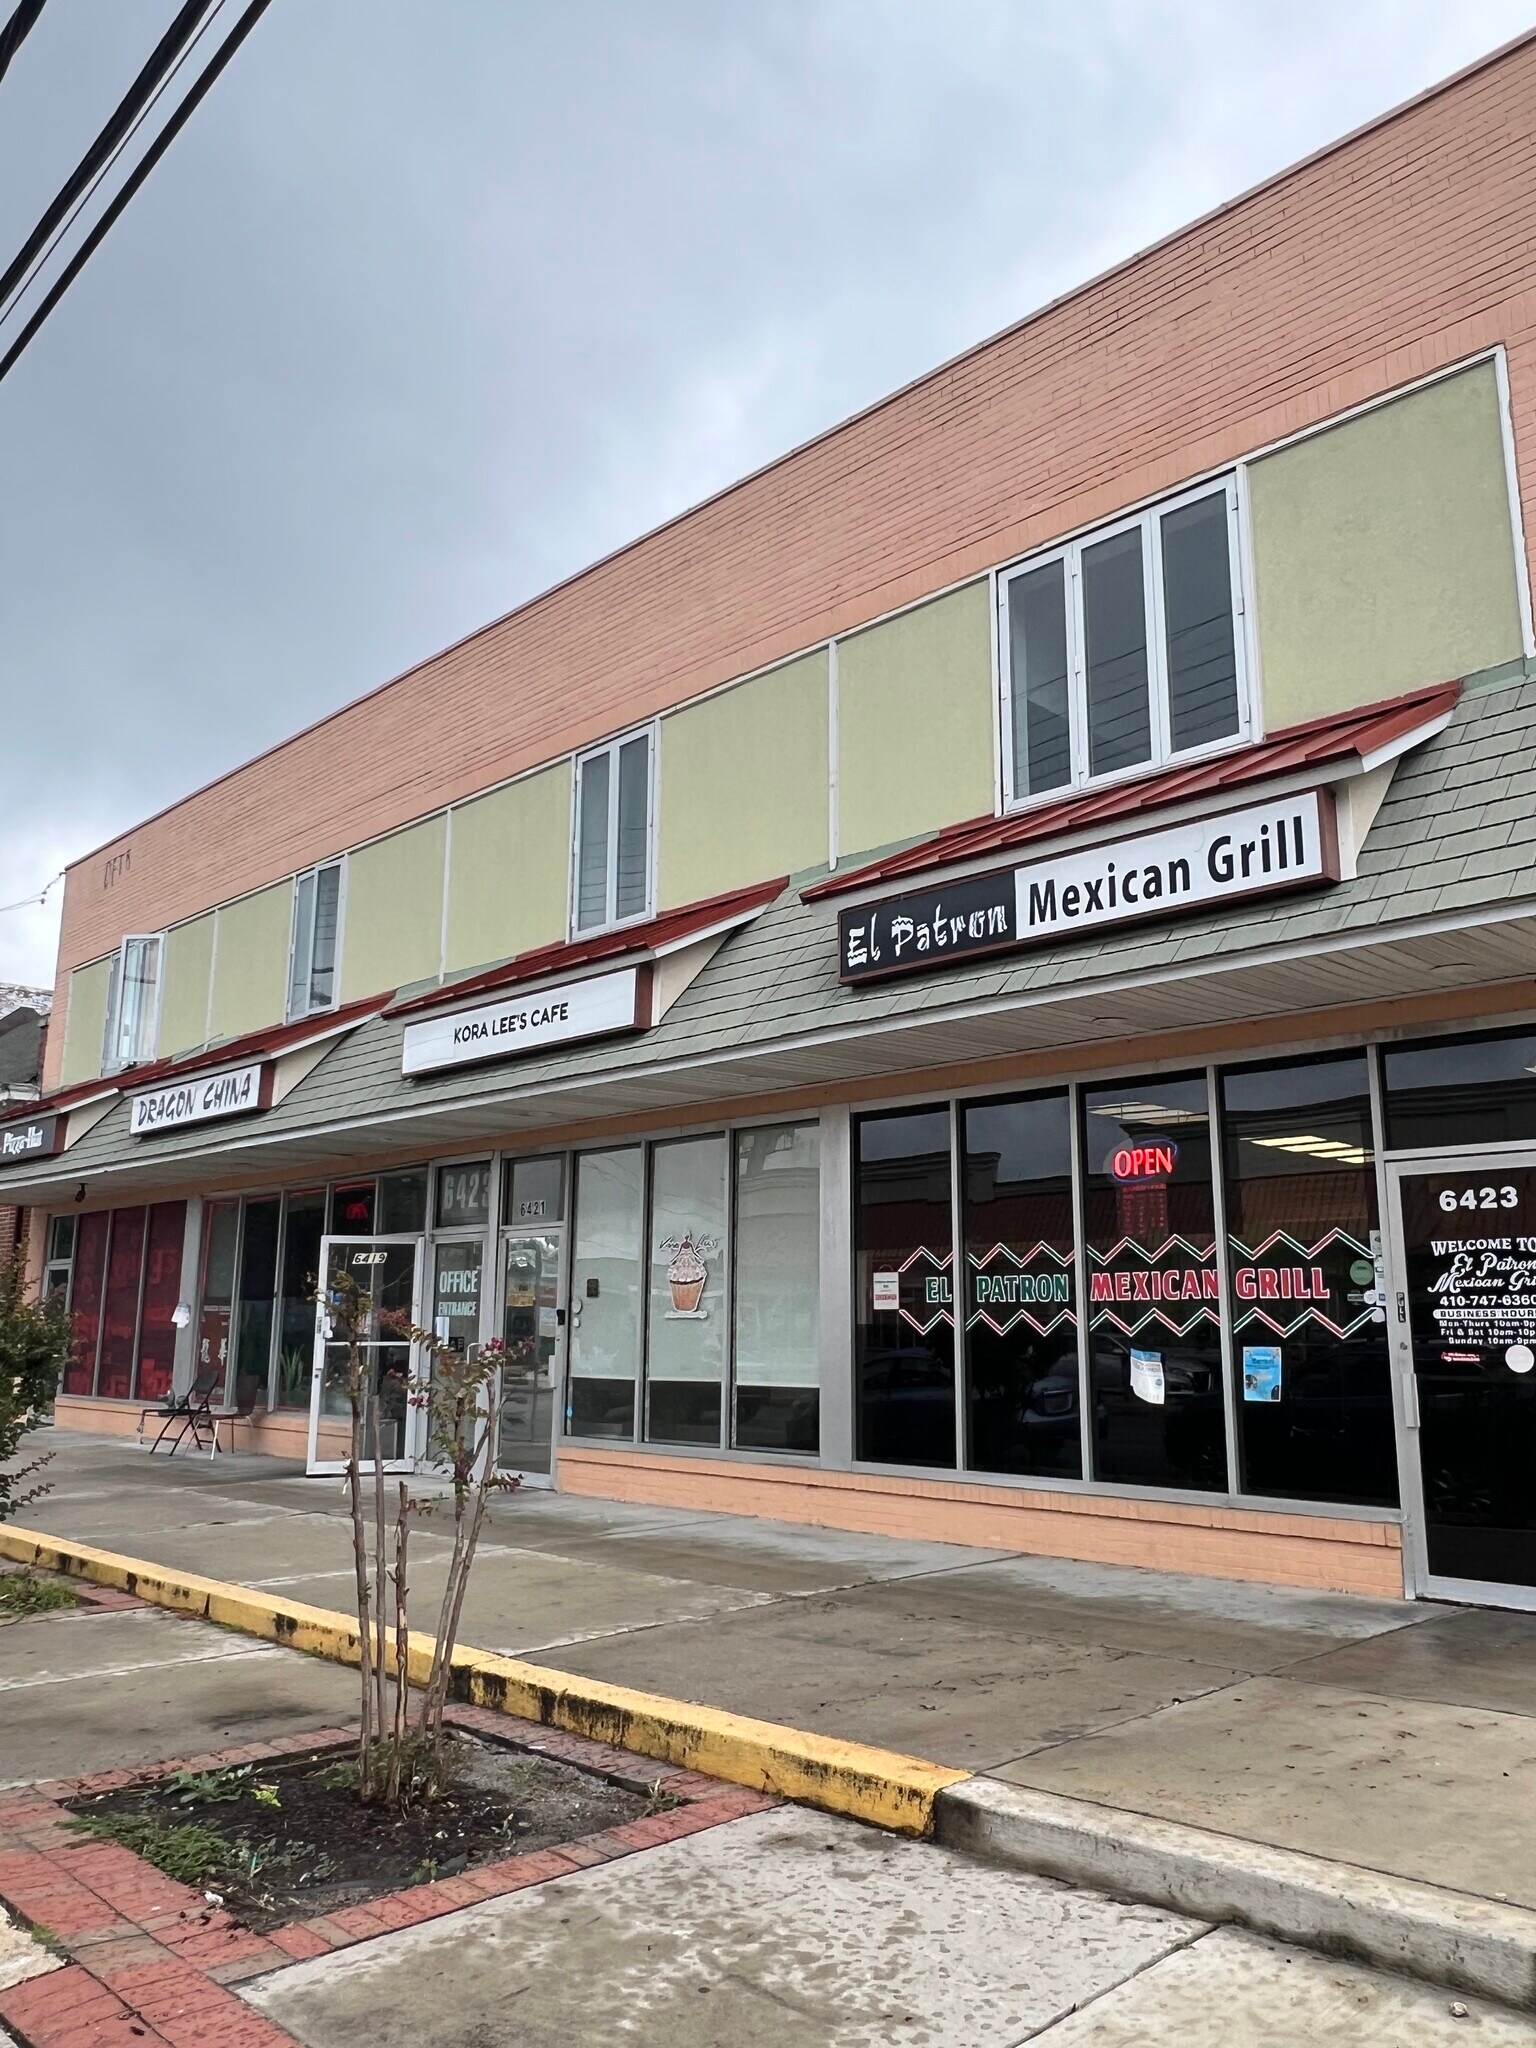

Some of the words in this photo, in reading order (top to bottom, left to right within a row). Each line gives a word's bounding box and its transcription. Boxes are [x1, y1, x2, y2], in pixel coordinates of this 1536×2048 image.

[846, 911, 882, 968] El
[891, 903, 1008, 957] Patron
[1028, 861, 1191, 926] Mexican
[1206, 815, 1306, 885] Grill
[453, 1021, 489, 1045] KORA
[492, 1012, 527, 1036] LEE'S
[530, 1001, 569, 1027] CAFE
[138, 1088, 197, 1127] DRAGON
[202, 1073, 251, 1111] CHINA
[1114, 1146, 1173, 1177] OPEN
[520, 1200, 546, 1217] 6421
[1439, 1185, 1519, 1212] 6423
[353, 1253, 387, 1263] 6419
[1430, 1238, 1512, 1257] WELCOME
[1516, 1236, 1536, 1253] TO
[1450, 1252, 1474, 1278] El
[1475, 1252, 1536, 1277] Patron
[439, 1269, 478, 1294] OFFICE
[925, 1276, 952, 1303] EL
[976, 1273, 1069, 1303] PATRON
[1090, 1268, 1219, 1301] MEXICAN
[1235, 1267, 1331, 1300] GRILL
[1427, 1271, 1506, 1294] Mexican
[437, 1301, 477, 1317] ENTRANCE
[1440, 1310, 1497, 1318] BUSINESS
[1501, 1309, 1536, 1317] HOUR
[1440, 1328, 1454, 1336] Fri
[1456, 1328, 1465, 1336] &
[1468, 1328, 1484, 1336] Sat
[1448, 1337, 1483, 1346] Sunday
